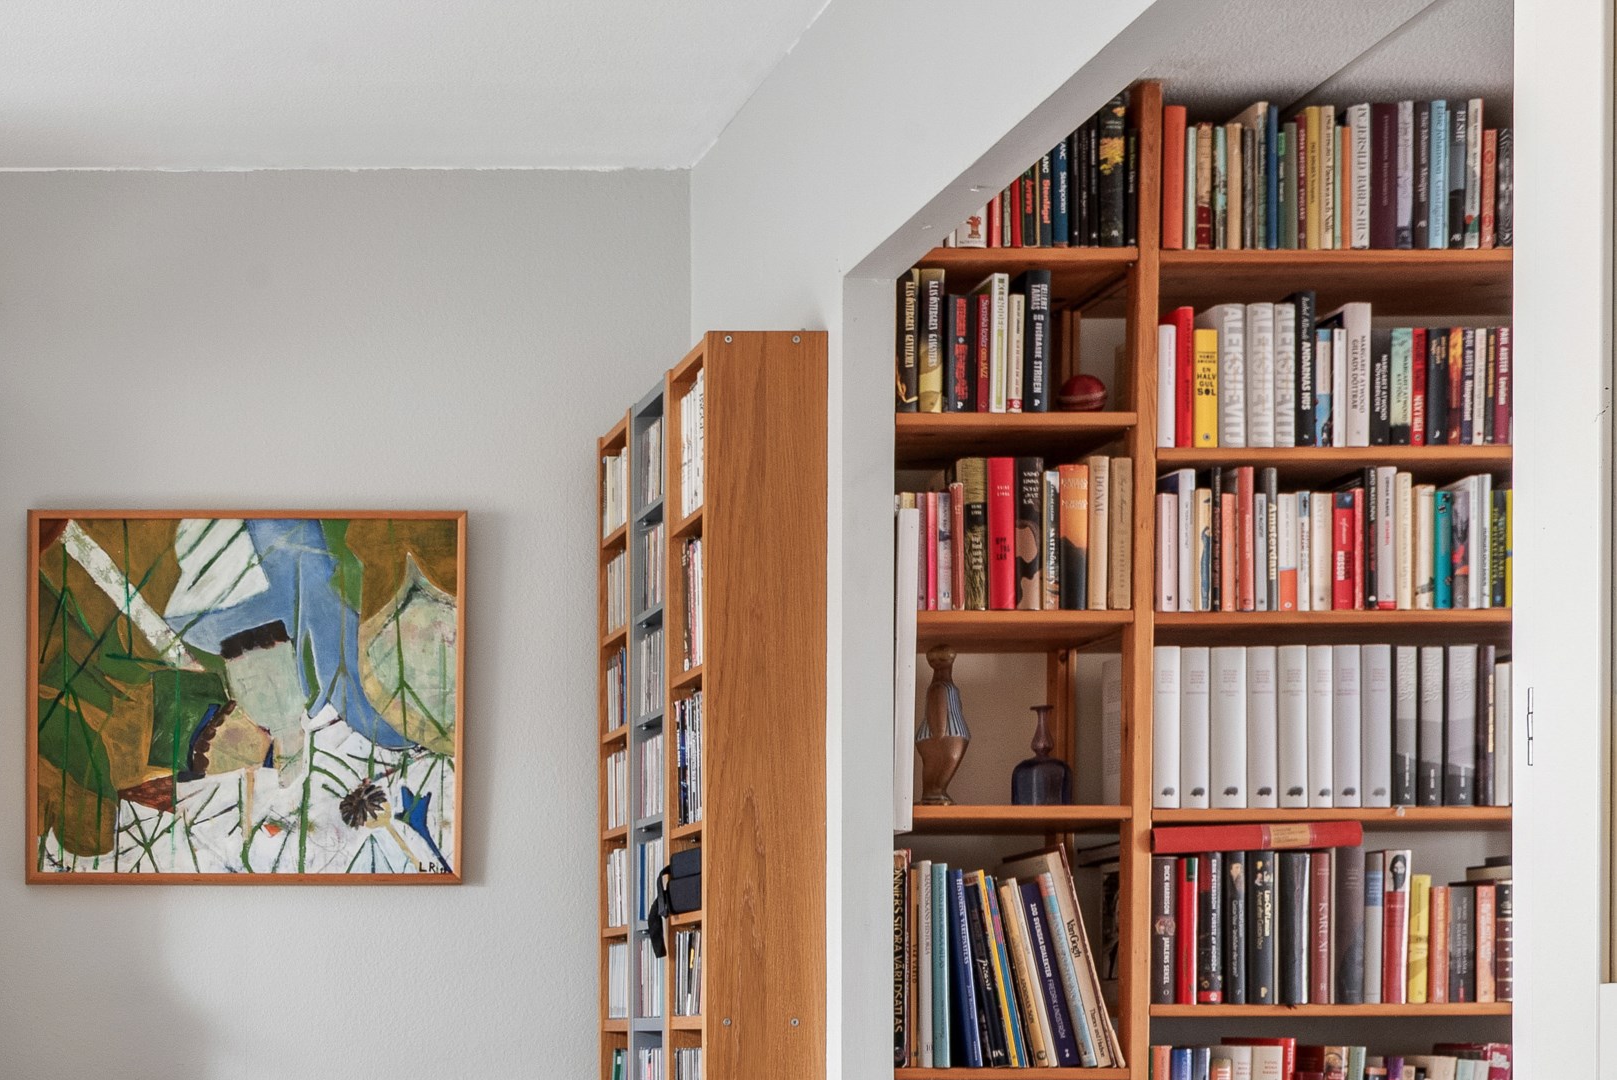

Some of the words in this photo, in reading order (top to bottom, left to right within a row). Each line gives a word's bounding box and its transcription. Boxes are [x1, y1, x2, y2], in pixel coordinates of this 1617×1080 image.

[1356, 125, 1366, 170] JERSILD
[1058, 171, 1067, 214] Stadsporten
[905, 297, 916, 331] ÖSTERGREN
[928, 296, 939, 330] ÖSTERGREN
[904, 334, 914, 368] GENTLEMEN
[927, 333, 937, 367] GANGSTERS
[1464, 330, 1473, 348] PAUL
[1499, 328, 1508, 345] PAUL
[1301, 341, 1311, 391] ANDARNAS
[1351, 338, 1359, 372] GILEADS
[1359, 335, 1367, 377] MARGARET
[1464, 349, 1472, 376] AUSTER
[1498, 346, 1507, 373] AUSTER
[1032, 360, 1042, 393] STRIDEN
[1197, 388, 1216, 396] SOL
[1350, 373, 1359, 410] DÖTTRAR
[1301, 392, 1310, 410] HUS
[1358, 378, 1366, 414] ATWOOD
[1268, 502, 1276, 580] Amsterdam
[894, 868, 902, 914] NNIERS
[955, 878, 965, 917] HISTORISK
[894, 915, 902, 952] STORA
[1032, 916, 1043, 945] SVENSKA
[1318, 902, 1327, 937] KARL
[959, 918, 969, 965] VÄRLDSATLAS
[1318, 939, 1327, 952] XI
[1038, 945, 1052, 978] DIALEKTER
[894, 954, 903, 1033] VÄRLDSATLAS
[1020, 977, 1030, 1009] APORNAS
[1026, 1009, 1034, 1024] SON
[1046, 978, 1057, 1004] FREDRIK
[1051, 1004, 1066, 1040] LINDSTRÖM
[1089, 1008, 1098, 1028] Thames
[1095, 1038, 1106, 1058] Hudson
